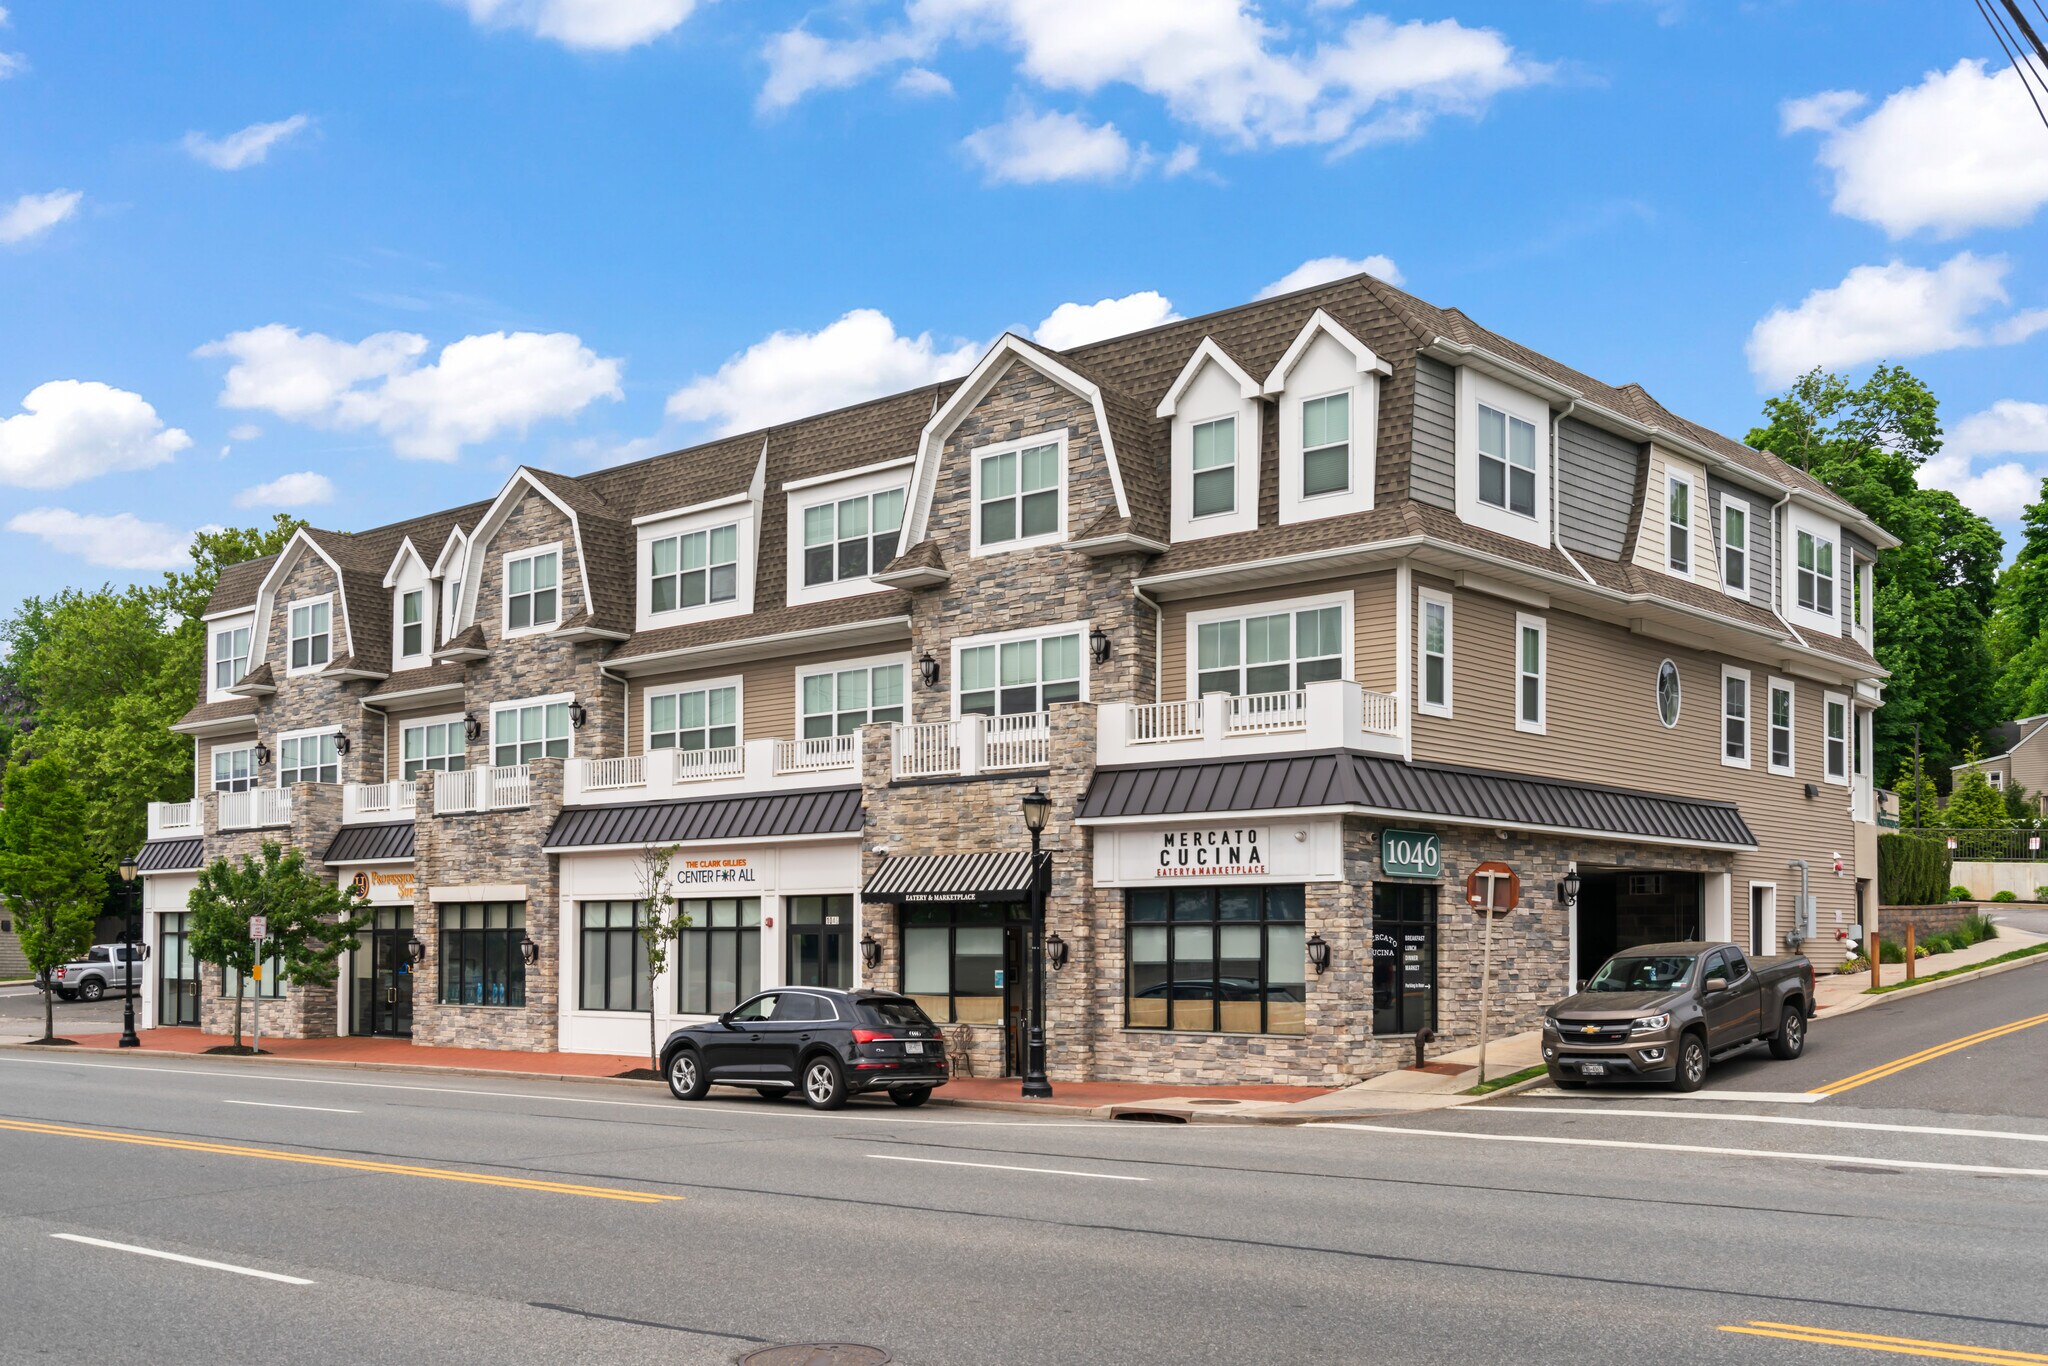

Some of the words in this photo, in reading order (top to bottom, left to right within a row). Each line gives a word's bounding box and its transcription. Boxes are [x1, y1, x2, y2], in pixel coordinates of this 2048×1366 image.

[1164, 829, 1257, 847] MERCATO
[1160, 846, 1261, 867] CUCINA
[1387, 836, 1438, 873] 1046
[700, 860, 721, 868] CLARK
[722, 859, 747, 867] GILLIES
[678, 870, 714, 884] CENTER
[738, 868, 756, 882] ALL
[933, 893, 976, 901] MARKETPLACE
